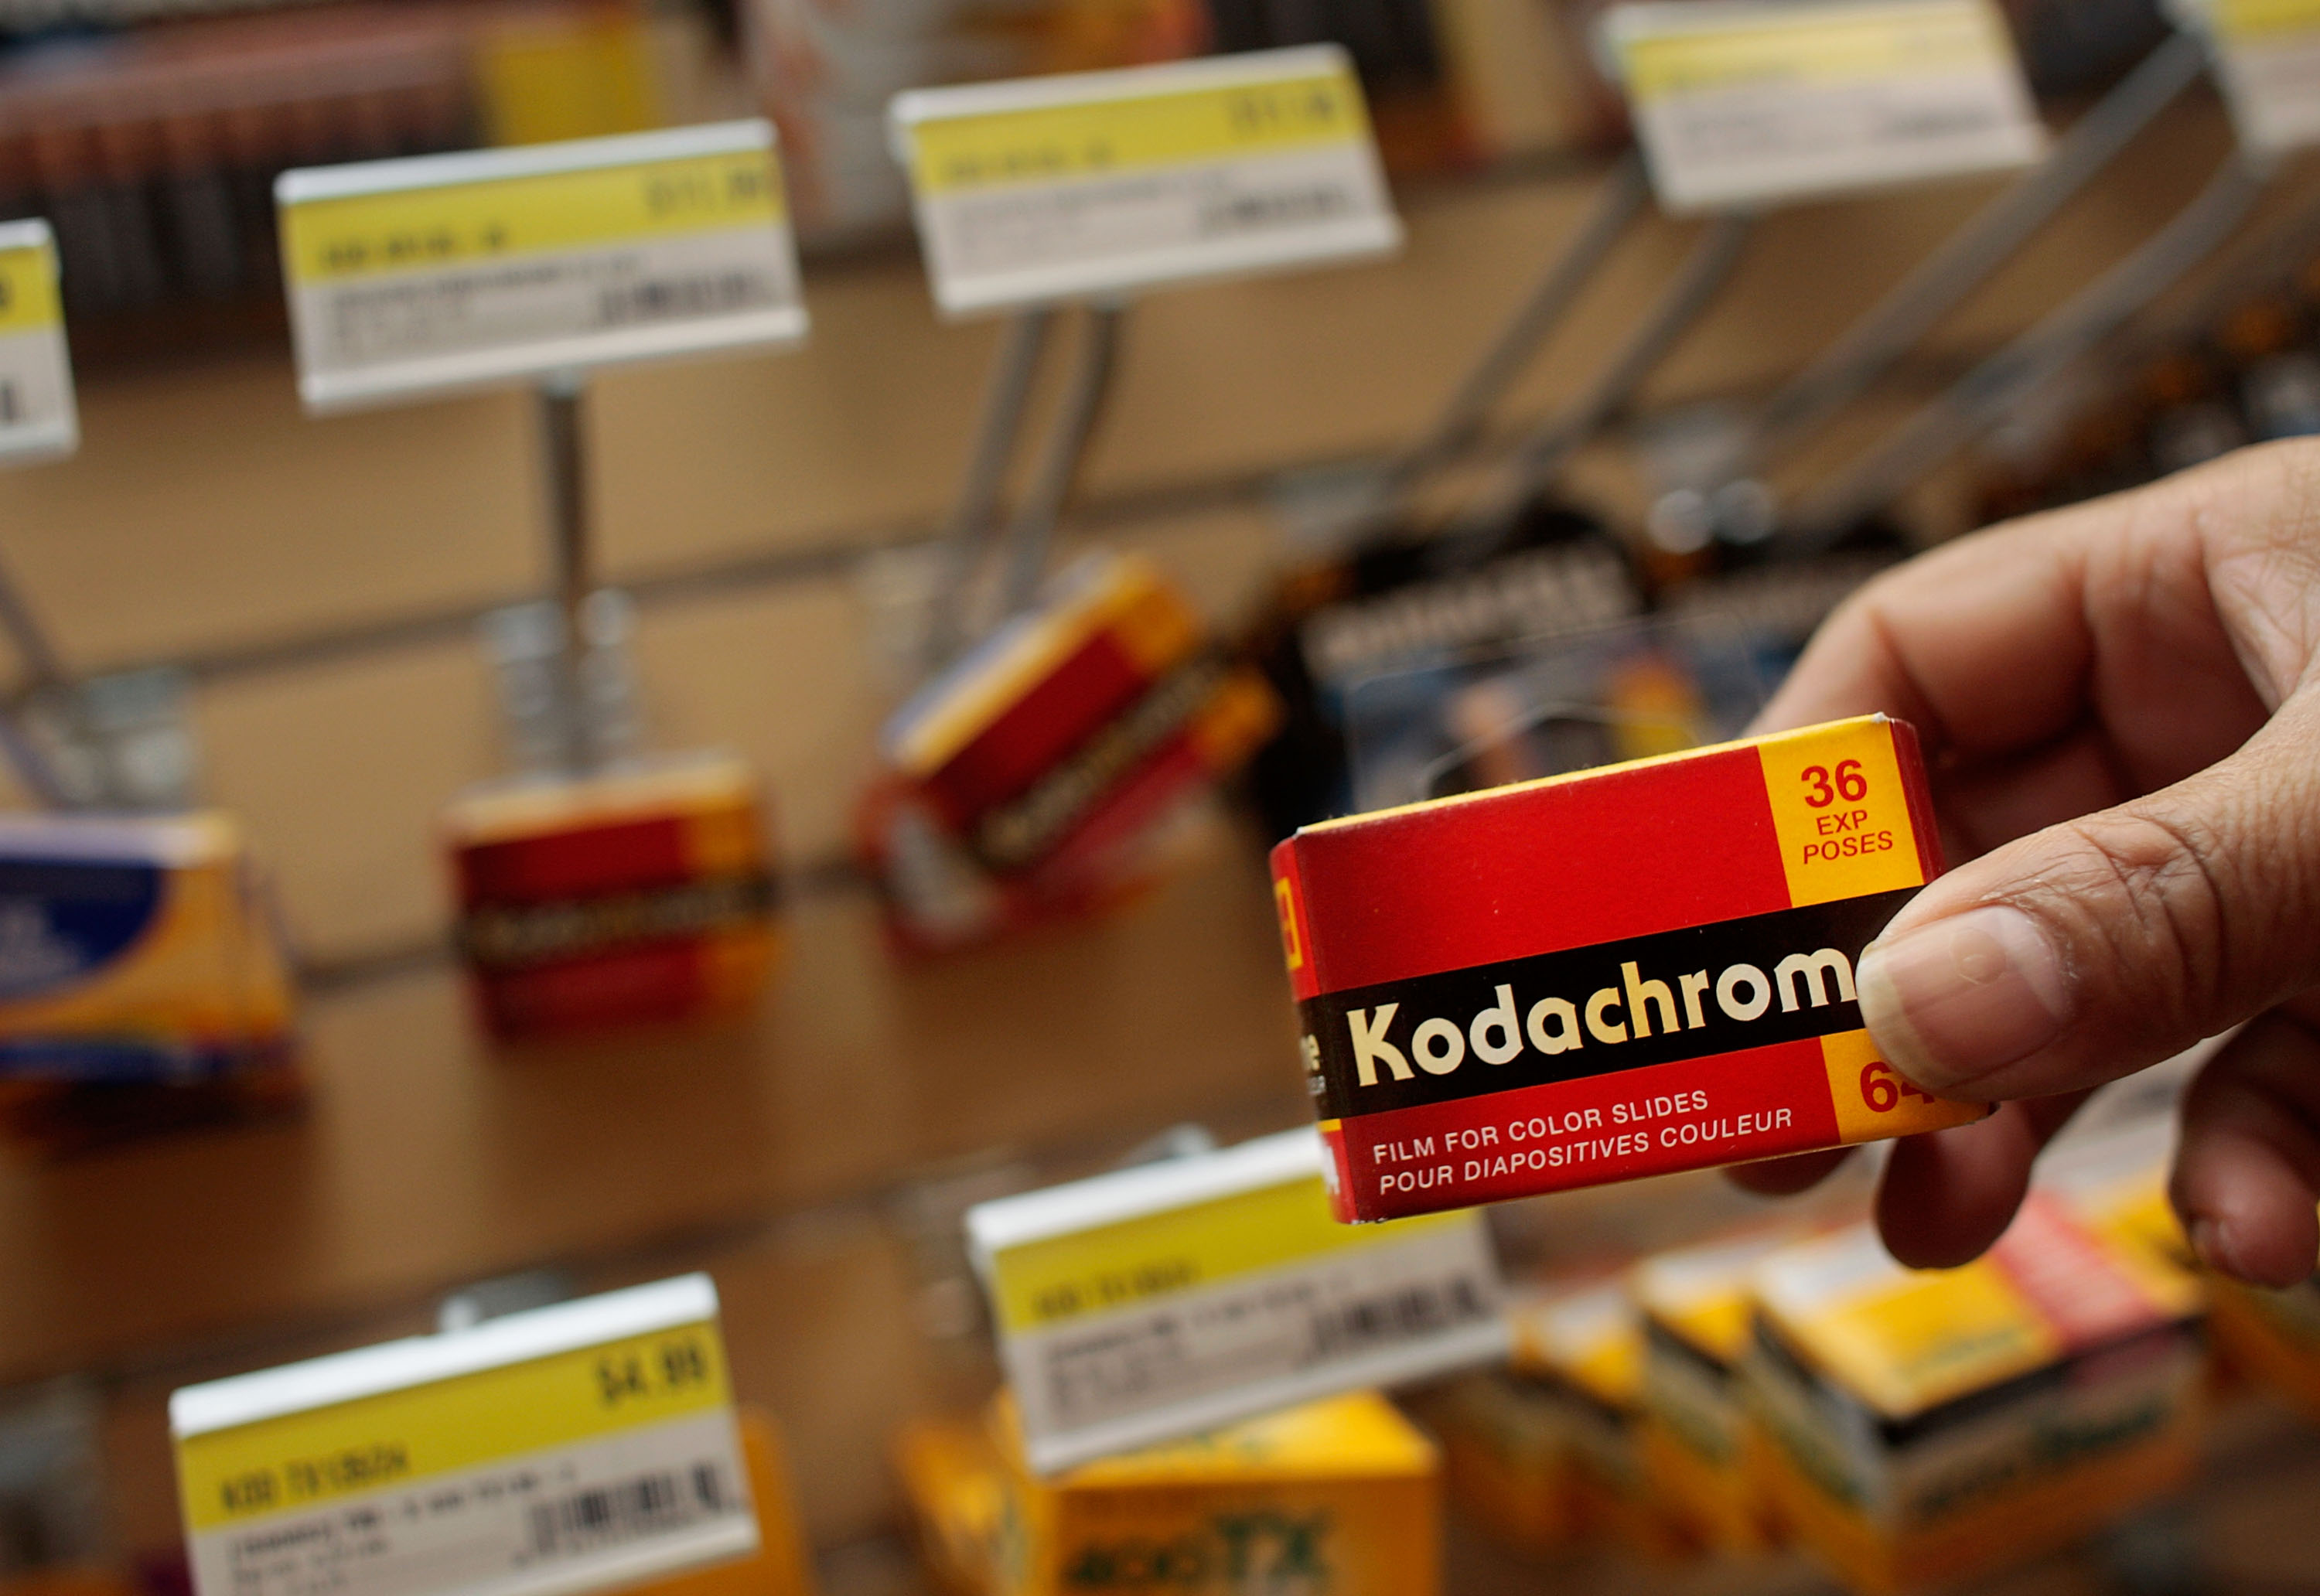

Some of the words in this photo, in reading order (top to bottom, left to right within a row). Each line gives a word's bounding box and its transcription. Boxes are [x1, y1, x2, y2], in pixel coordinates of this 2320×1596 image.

[1801, 759, 1868, 808] 36
[1803, 830, 1893, 864] POSES
[1816, 810, 1868, 835] EXP
[1346, 947, 1858, 1087] Kodachrom
[1373, 1136, 1435, 1165] FILM
[1445, 1126, 1499, 1151] FOR
[1508, 1108, 1602, 1140] COLOR
[1612, 1090, 1708, 1124] SLIDES
[1380, 1165, 1454, 1195] POUR
[1463, 1131, 1651, 1181] DIAPOSITIVES
[1660, 1107, 1793, 1148] COULEUR
